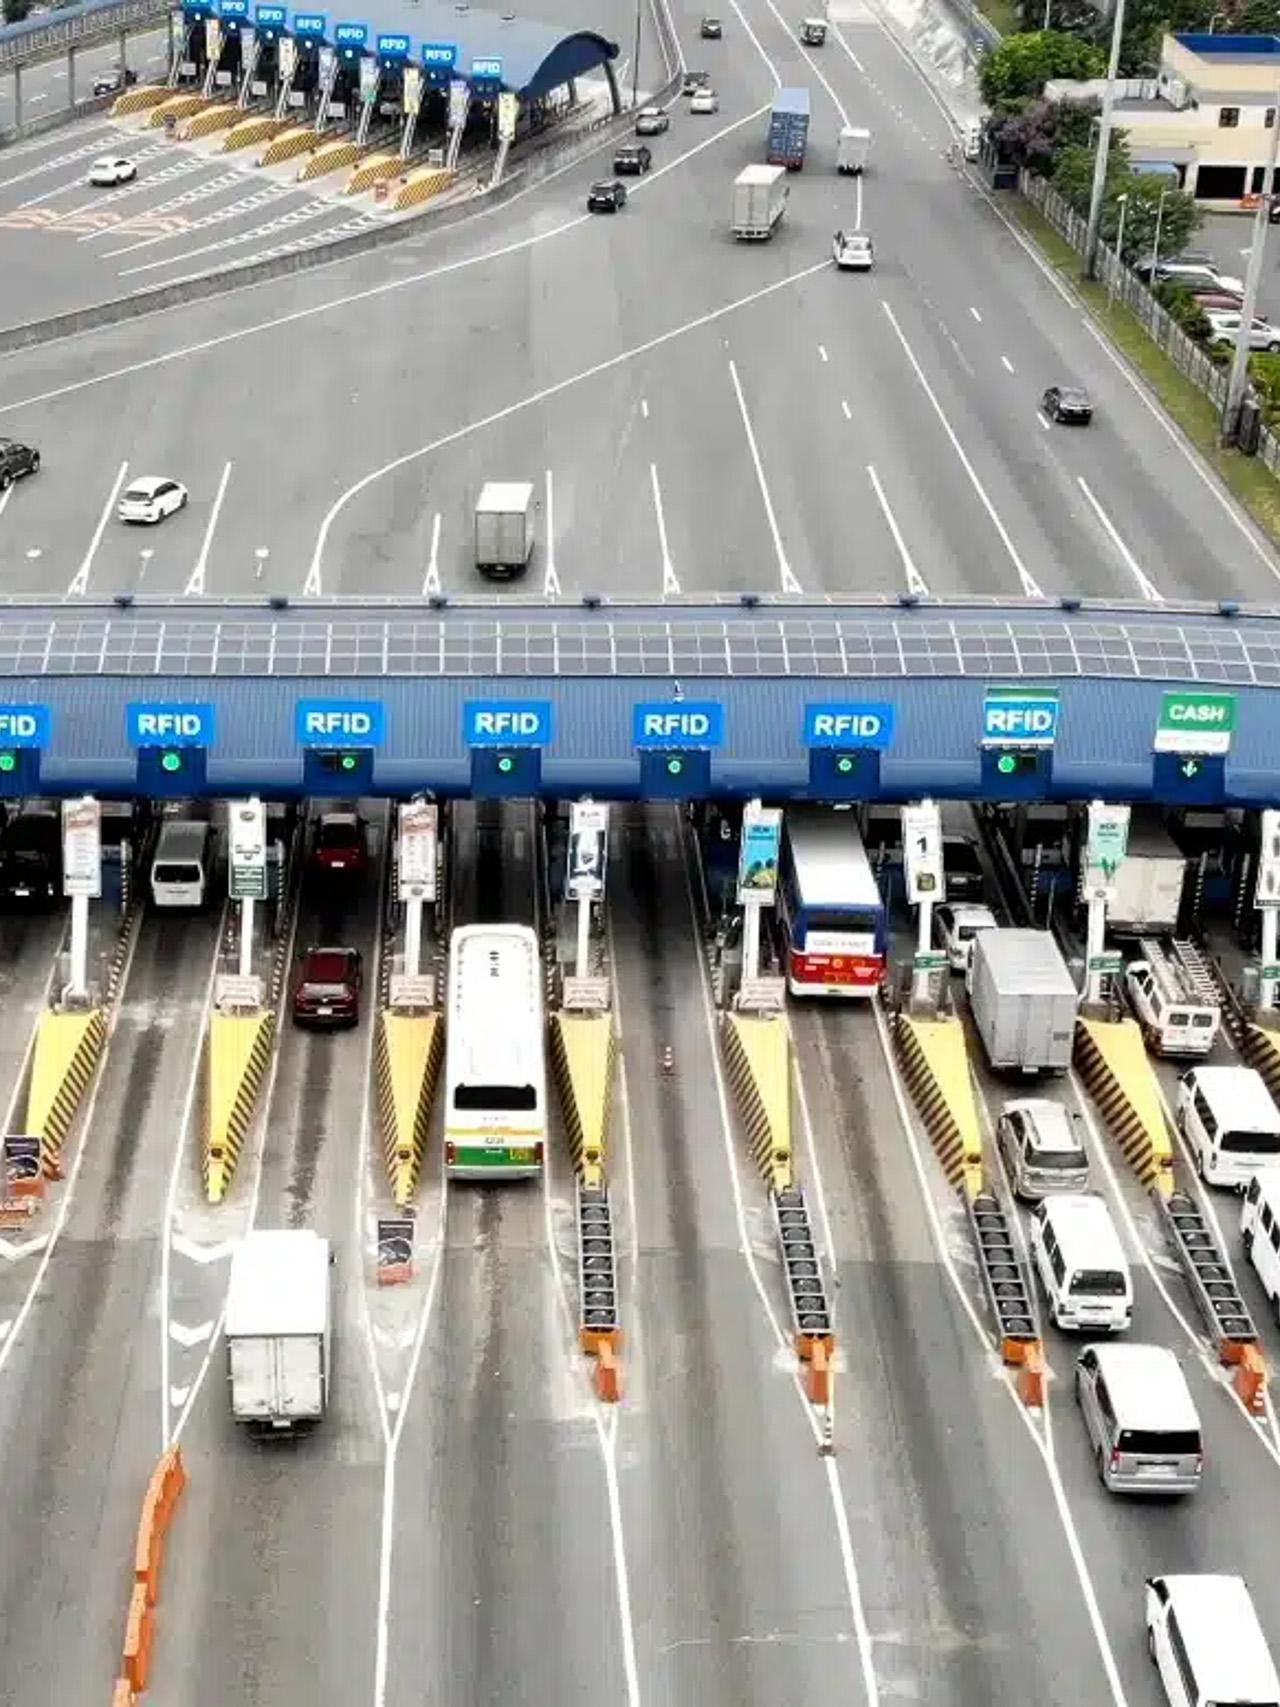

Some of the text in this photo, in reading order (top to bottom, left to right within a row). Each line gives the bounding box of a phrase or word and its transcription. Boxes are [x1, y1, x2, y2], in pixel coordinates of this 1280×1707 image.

[337, 28, 363, 39] RFID
[380, 38, 406, 50] RFID
[426, 49, 452, 61] RFID
[472, 61, 500, 74] RFID
[307, 711, 371, 734] RFID
[476, 711, 539, 734] RFID
[645, 713, 709, 735] RFID
[986, 709, 1053, 732] RFID
[1169, 704, 1226, 722] CASH
[139, 713, 201, 736] RFID
[814, 715, 880, 737] RFID
